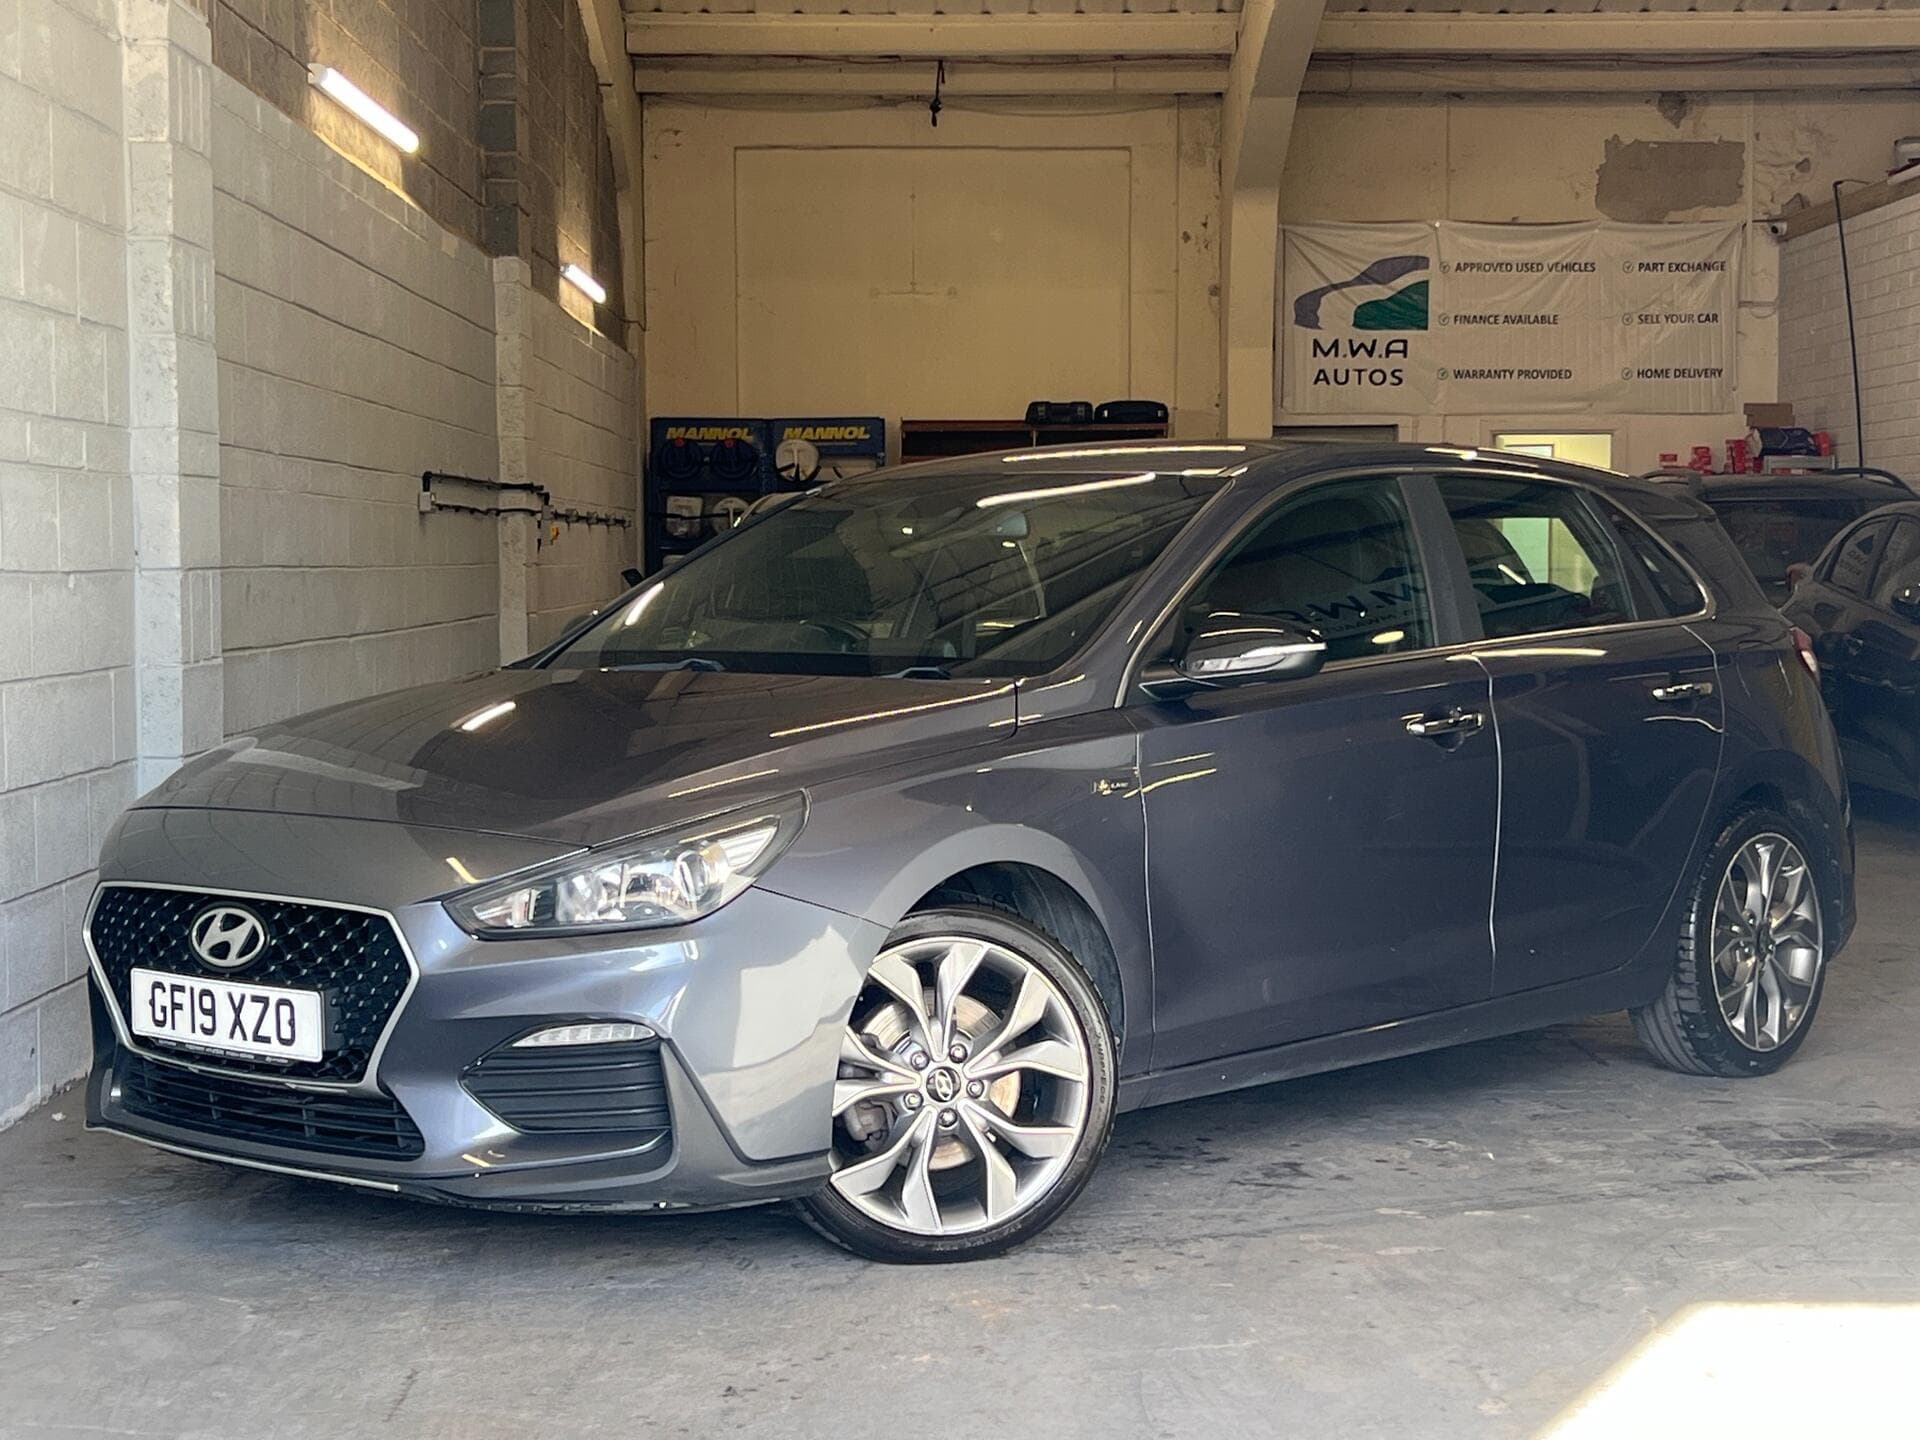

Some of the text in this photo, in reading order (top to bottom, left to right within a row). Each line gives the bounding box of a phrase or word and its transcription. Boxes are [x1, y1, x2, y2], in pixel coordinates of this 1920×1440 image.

[1455, 261, 1596, 273] APPROVED USED VEHICLES
[1637, 261, 1726, 273] PART EXCHANGE
[1453, 313, 1559, 326] FINANCE AVAILABLE
[1637, 312, 1719, 325] SELL YOUR CAR
[1312, 338, 1409, 359] M.W.A
[1312, 368, 1404, 387] AUTOS
[1453, 368, 1573, 380] WARRANTY PROVIDED
[1636, 367, 1723, 379] HOME DELIVERY
[666, 427, 753, 440] MANNOL
[782, 427, 871, 440] MANNOL
[150, 981, 296, 1046] GF19 XZO
